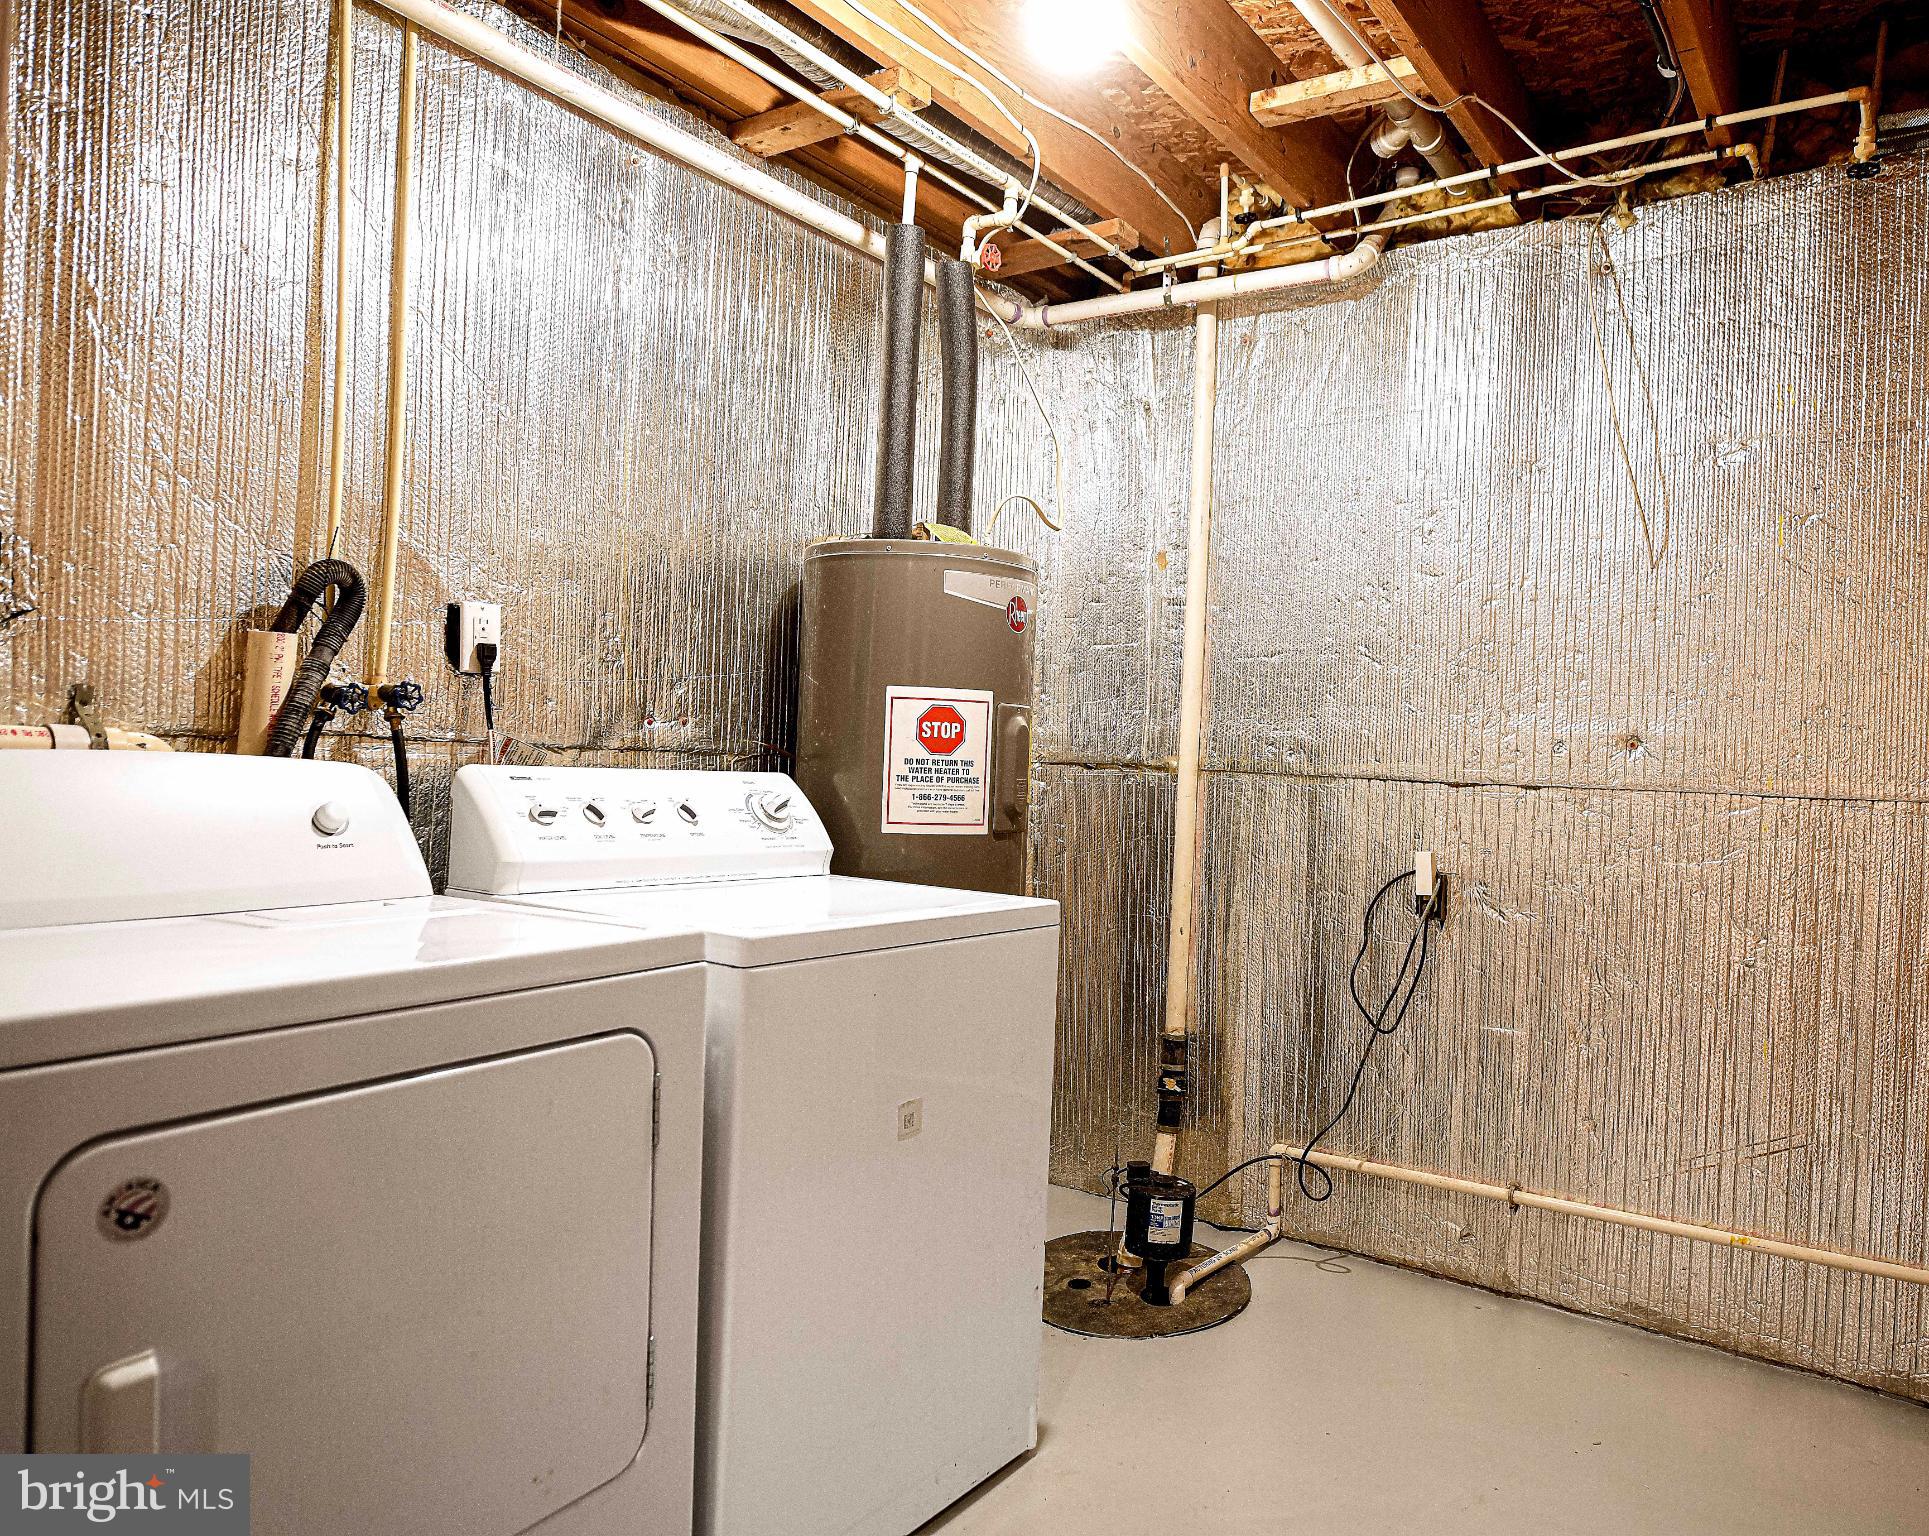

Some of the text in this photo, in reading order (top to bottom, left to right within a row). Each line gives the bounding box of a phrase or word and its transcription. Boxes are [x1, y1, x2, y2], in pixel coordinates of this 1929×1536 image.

[921, 722, 961, 738] STOP
[904, 758, 914, 766] DO
[932, 759, 958, 767] RETURN
[960, 760, 974, 768] THIS
[908, 766, 932, 774] WATER
[934, 767, 960, 775] HEATER
[912, 793, 966, 802] 1-866-279-4566
